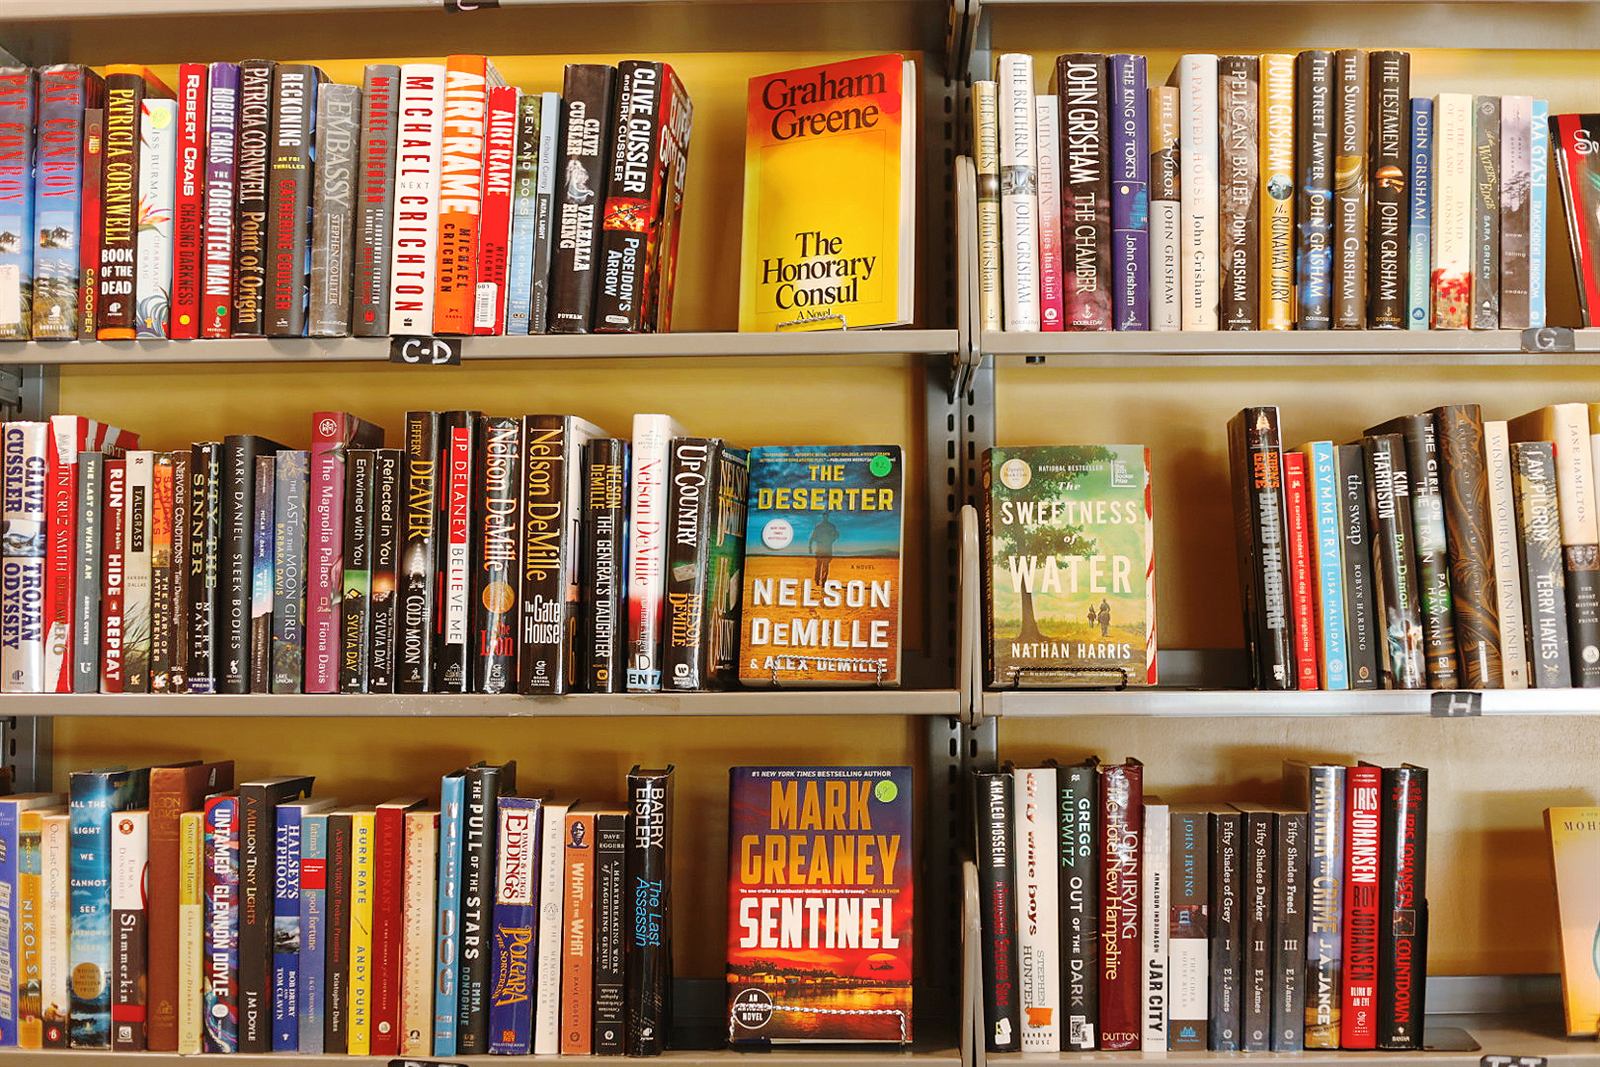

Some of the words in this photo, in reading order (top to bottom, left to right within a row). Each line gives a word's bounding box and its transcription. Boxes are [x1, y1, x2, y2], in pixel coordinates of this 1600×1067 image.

[631, 68, 655, 116] CLIVE
[762, 70, 887, 111] Graham
[1067, 61, 1098, 104] JOHN
[1124, 62, 1134, 85] THE
[211, 88, 235, 130] ROBERT
[241, 68, 269, 129] PATRICIA
[279, 74, 303, 146] RECKONING
[1124, 89, 1136, 117] KING
[1232, 70, 1247, 148] PELICAN
[107, 89, 135, 157] PATRICIA
[402, 76, 434, 177] MICHAEL
[524, 106, 533, 134] MEN
[771, 104, 879, 140] Greene
[1125, 120, 1136, 136] OF
[210, 131, 233, 164] CRAIS
[324, 100, 351, 208] EMBASSY
[440, 71, 486, 216] AIRFRAME
[487, 109, 514, 196] AIRFRAME
[523, 142, 532, 170] AND
[624, 119, 651, 192] CUSSLER
[1069, 109, 1100, 184] GRISHAM
[1125, 140, 1136, 178] TORTS
[240, 130, 267, 204] CORNWELL
[1232, 156, 1247, 205] BRIEF
[105, 163, 131, 244] CORNWELL
[520, 178, 530, 216] DOGS
[1074, 192, 1096, 222] THE
[207, 181, 232, 262] FORGOTTEN
[241, 212, 265, 252] Point
[328, 214, 339, 257] STEPHEN
[538, 219, 547, 239] LIGHT
[561, 204, 575, 249] RISING
[574, 204, 593, 271] VALHALLA
[1192, 215, 1205, 246] John
[1233, 214, 1246, 245] JOHN
[101, 249, 133, 263] BOOK
[395, 196, 428, 311] CRICHTON
[795, 232, 842, 257] The
[1075, 225, 1096, 294] CHAMBER
[1272, 216, 1289, 271] RUNAWAY
[101, 266, 116, 277] OF
[117, 266, 133, 277] THE
[206, 264, 229, 295] MAN
[241, 256, 262, 273] of
[328, 259, 338, 304] COULTER
[761, 256, 876, 285] Honorary
[1193, 251, 1205, 309] Grisham
[1233, 250, 1246, 300] GRISHAM
[101, 281, 131, 294] DEAD
[235, 276, 262, 323] Origin
[775, 276, 858, 310] Consul
[1271, 274, 1289, 303] JURY
[402, 339, 451, 365] C-D
[1536, 328, 1556, 350] G
[6, 429, 23, 512] CUSSLER
[235, 447, 245, 484] MARK
[320, 458, 332, 480] The
[528, 426, 563, 496] Nelson
[808, 465, 845, 481] THE
[25, 456, 44, 513] CLIVE
[86, 483, 94, 507] LAST
[110, 468, 123, 508] RUN
[355, 459, 366, 512] Entwined
[381, 459, 393, 520] Reflected
[408, 460, 434, 541] DEAVER
[453, 462, 466, 537] DELANEY
[758, 489, 894, 511] DESERTER
[1347, 474, 1361, 498] the
[1373, 452, 1394, 518] HARRISON
[1393, 471, 1408, 496] KIM
[86, 510, 93, 524] OF
[134, 490, 143, 547] TALLGRASS
[192, 473, 203, 576] SINNER
[233, 491, 243, 541] DANIEL
[318, 486, 332, 543] Magnolia
[1001, 501, 1137, 524] SWEETNESS
[1319, 452, 1337, 558] ASYMMETRY
[1347, 504, 1362, 545] swap
[85, 527, 93, 555] WHAT
[354, 516, 365, 541] with
[381, 524, 391, 536] in
[527, 501, 560, 581] DeMille
[1064, 535, 1077, 545] of
[85, 564, 91, 579] AM
[233, 553, 242, 591] SLEEK
[320, 548, 332, 587] Palace
[353, 544, 364, 565] You
[380, 540, 391, 565] You
[108, 554, 121, 595] HIDE
[451, 548, 464, 611] BELIEVE
[753, 578, 891, 607] NELSON
[1008, 555, 1132, 593] WATER
[1438, 573, 1448, 613] PAULA
[1536, 575, 1556, 614] TERRY
[3, 563, 19, 650] ODYSSEY
[21, 563, 42, 642] TROJAN
[1428, 587, 1440, 646] HAWKINS
[231, 599, 242, 649] BODIES
[318, 622, 330, 650] Fiona
[451, 620, 462, 640] ME
[595, 601, 611, 657] DAUGHTER
[1541, 618, 1559, 659] HAYES
[106, 616, 120, 681] REPEAT
[318, 655, 329, 683] Davis
[1012, 643, 1069, 658] NATHAN
[1078, 643, 1131, 659] HARRIS
[1449, 694, 1472, 713] H
[472, 780, 481, 799] THE
[771, 780, 872, 830] MARK
[468, 804, 483, 851] PULL
[636, 788, 649, 849] EISLER
[1061, 789, 1073, 867] HURWITZ
[1079, 798, 1090, 856] GREGG
[1223, 821, 1232, 845] Fifty
[214, 808, 230, 874] UNTAMED
[358, 828, 367, 867] BURN
[503, 814, 528, 898] EDDINGS
[741, 835, 900, 885] GREANEY
[1352, 811, 1377, 882] JOHANSEN
[276, 825, 286, 899] TYPHOON
[288, 825, 299, 899] HALSEY'S
[469, 872, 478, 892] THE
[471, 856, 478, 869] OF
[1224, 847, 1232, 883] Shades
[358, 871, 366, 904] RATE
[1070, 876, 1082, 912] OUT
[1224, 886, 1232, 895] of
[214, 885, 230, 948] GLENNON
[465, 896, 481, 959] STARS
[636, 877, 649, 946] Assassin
[739, 897, 899, 949] SENTINEL
[1073, 918, 1080, 931] OF
[1222, 898, 1232, 922] Grey
[120, 914, 135, 1003] Slammerkin
[213, 953, 228, 996] DOYLE
[356, 946, 365, 980] ANDY
[1149, 960, 1163, 991] JAR
[1071, 960, 1083, 1006] DARK
[1395, 940, 1411, 1022] COUNTDOWN
[356, 989, 365, 1026] DUNN
[1150, 996, 1162, 1031] CITY
